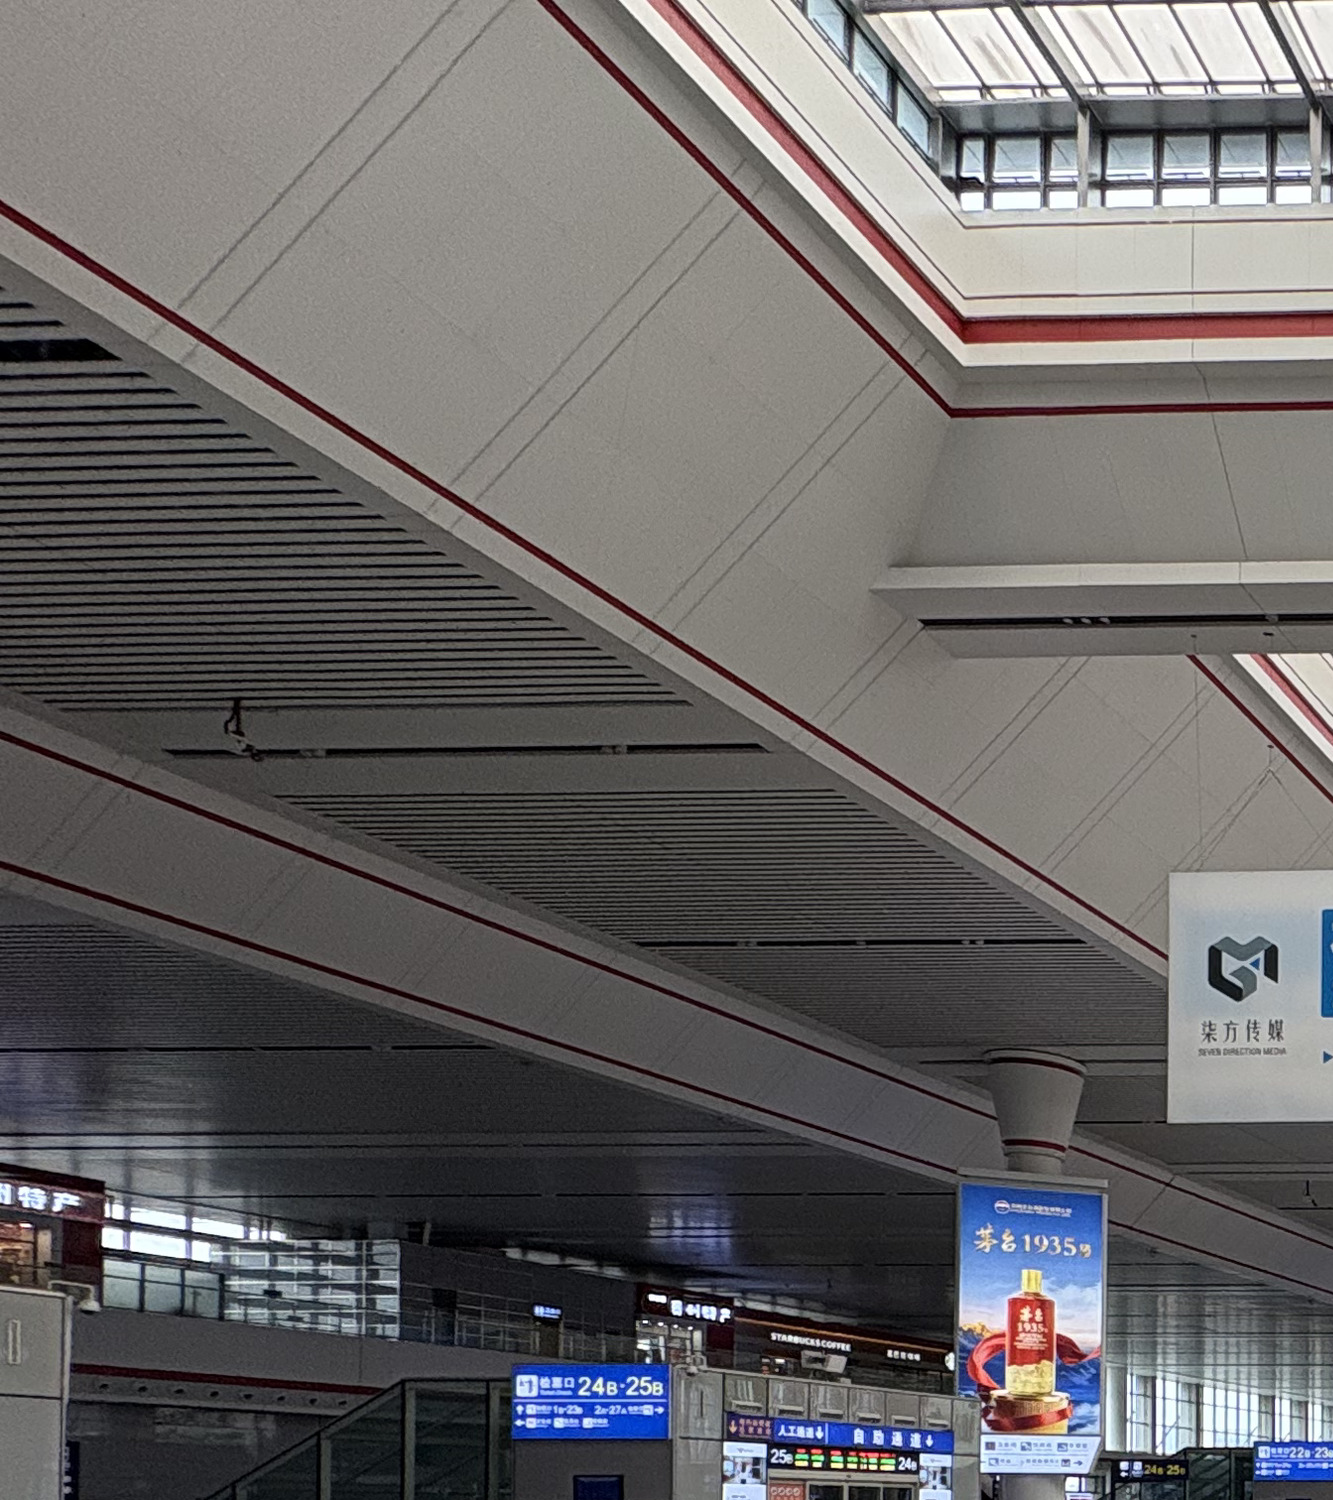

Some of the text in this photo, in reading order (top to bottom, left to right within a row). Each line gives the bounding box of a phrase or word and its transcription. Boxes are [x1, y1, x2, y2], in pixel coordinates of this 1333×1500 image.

[1200, 1018, 1285, 1043] 柒方传媒
[770, 1332, 851, 1352] STARBUCKS COFFEE
[853, 1428, 922, 1448] 自助通道
